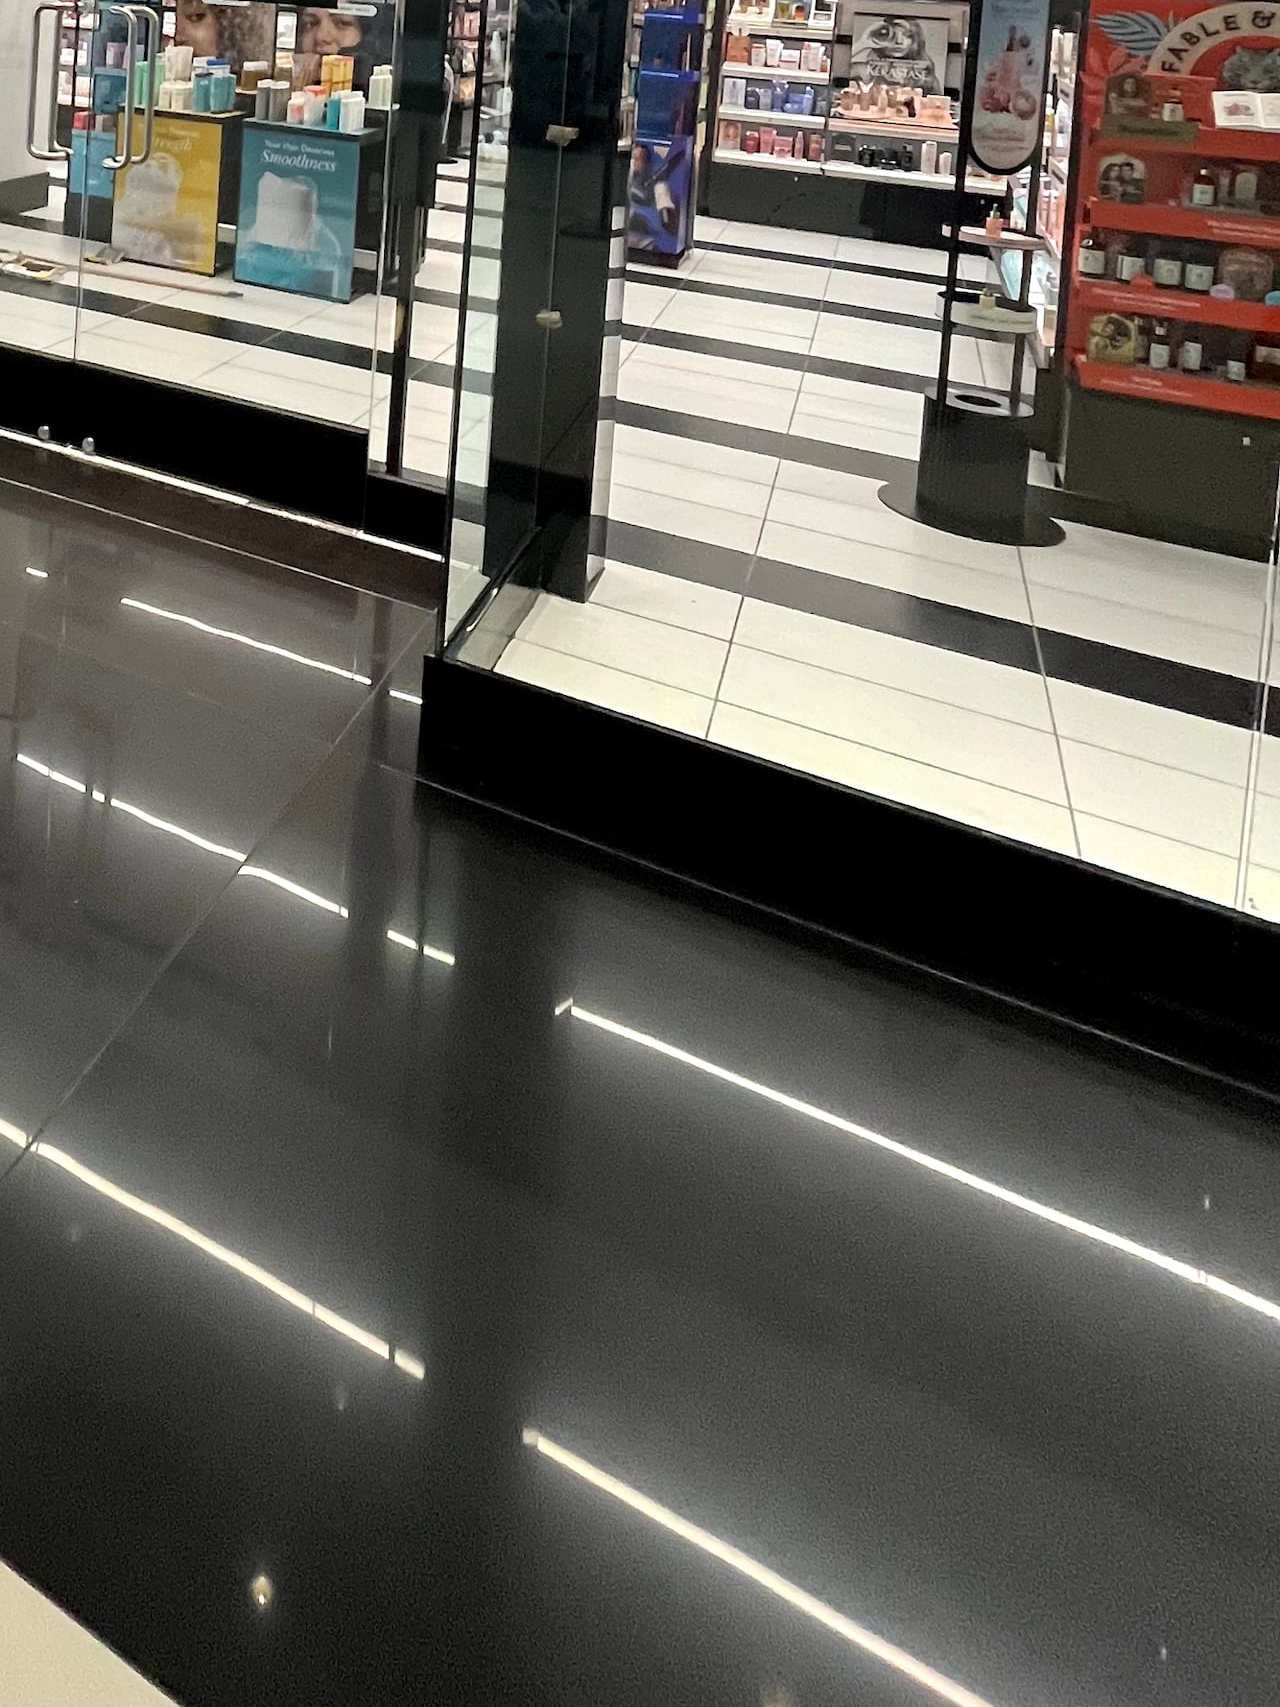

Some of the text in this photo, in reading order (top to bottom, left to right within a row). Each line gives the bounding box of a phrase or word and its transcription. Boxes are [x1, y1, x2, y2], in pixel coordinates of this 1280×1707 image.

[1160, 9, 1277, 74] FABLE &
[262, 149, 338, 173] Smoothness
